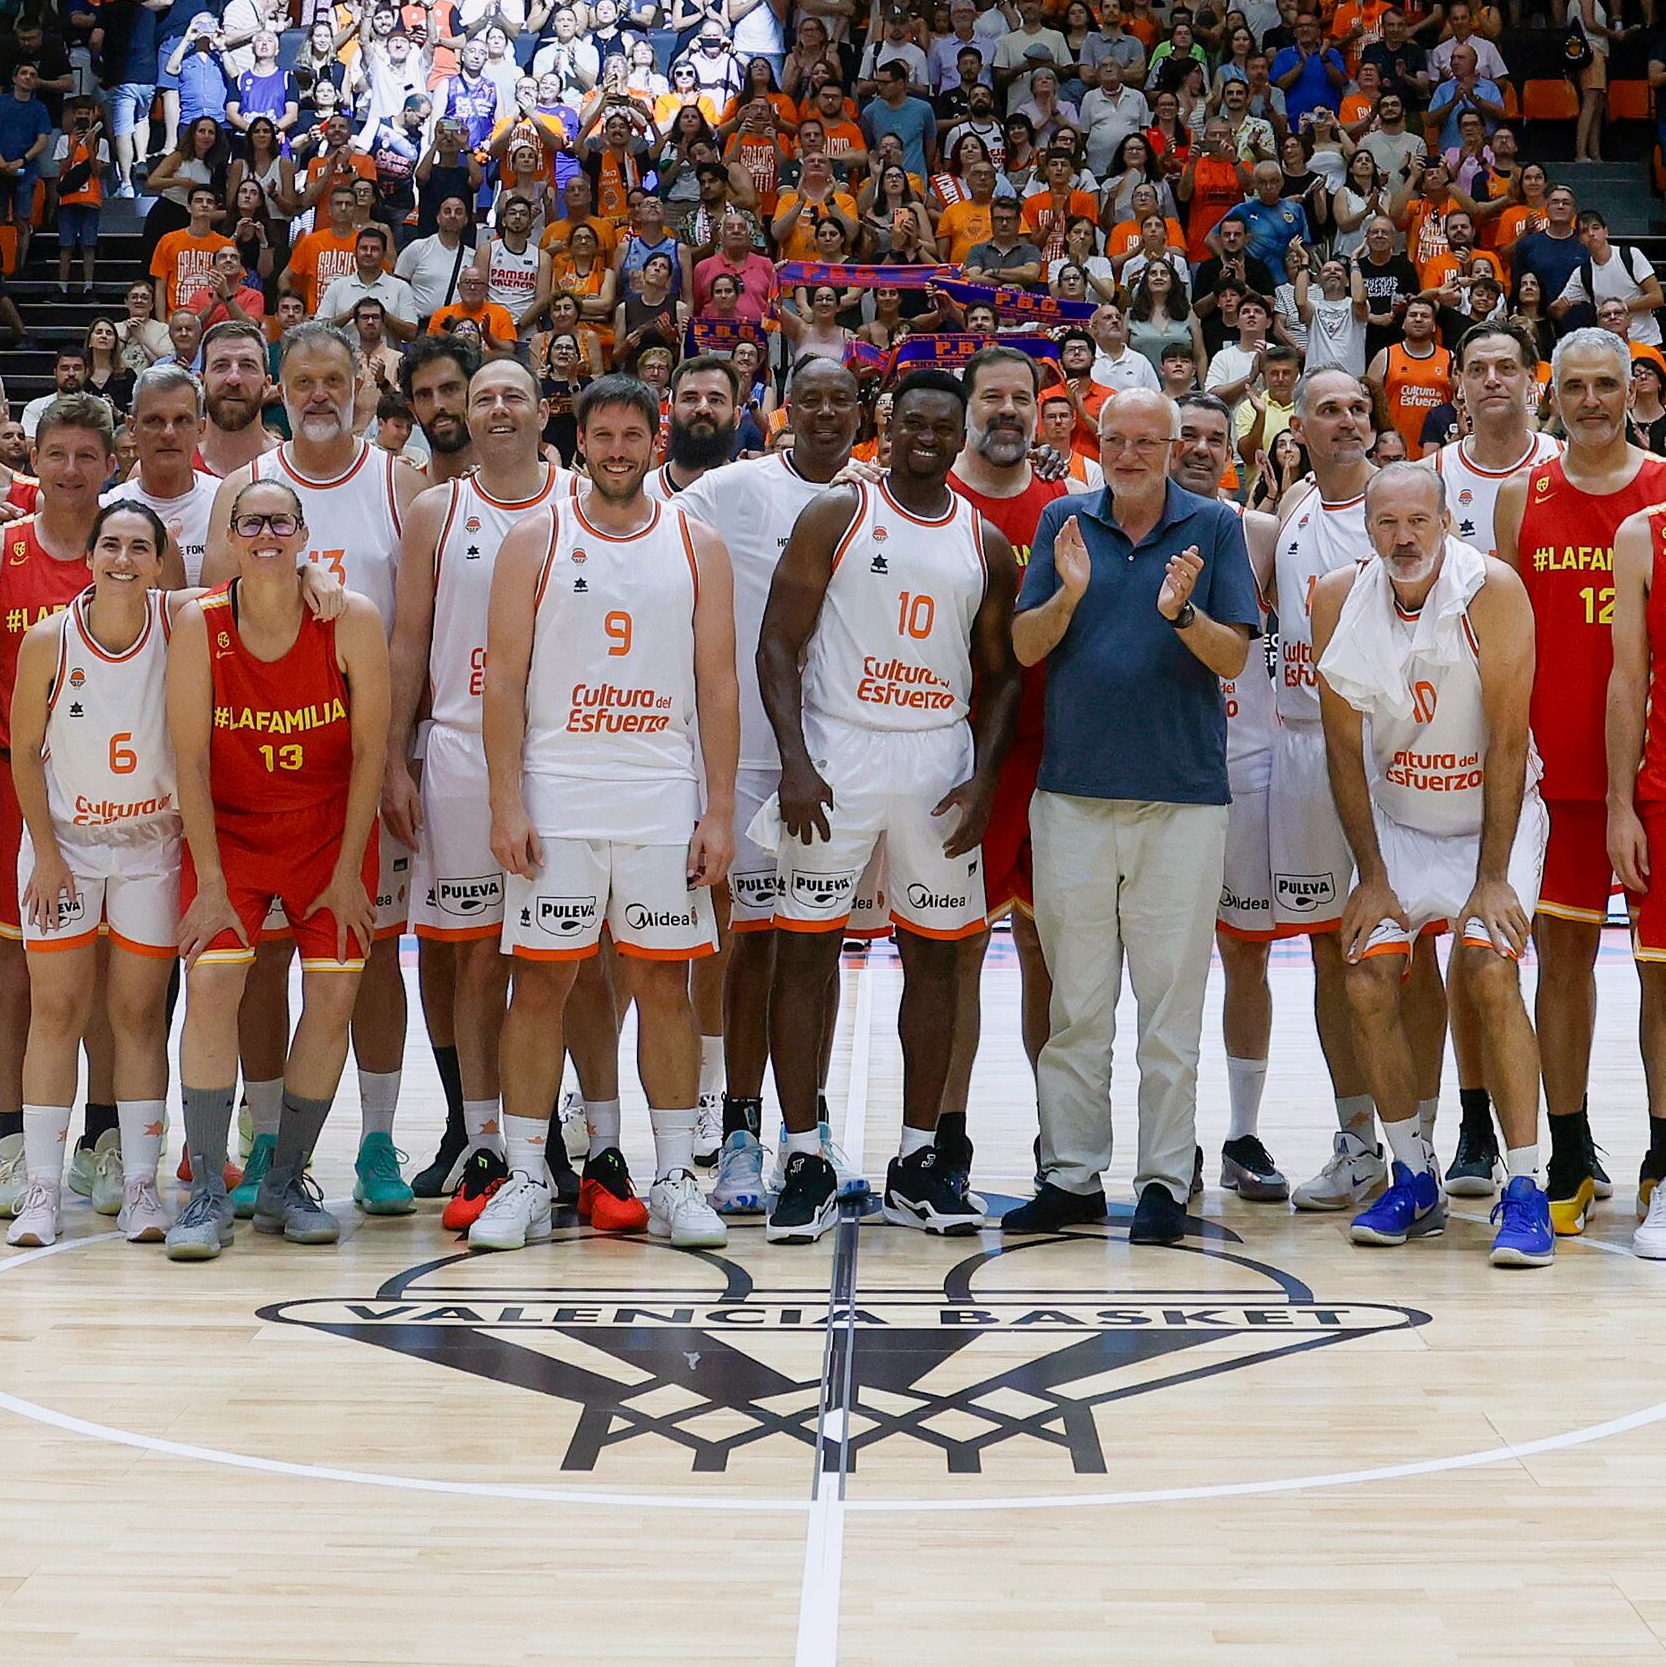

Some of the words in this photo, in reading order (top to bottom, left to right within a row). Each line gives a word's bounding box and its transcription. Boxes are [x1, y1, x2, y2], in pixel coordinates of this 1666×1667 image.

[490, 268, 536, 281] PAMESA
[1400, 385, 1435, 396] Cultura
[897, 590, 935, 640] 10
[1578, 586, 1615, 624] 12
[604, 609, 633, 657] 9
[571, 682, 655, 710] Cultura
[655, 694, 672, 709] del
[856, 677, 955, 711] Esfuerzo
[213, 697, 346, 735] #LAFAMILIA
[565, 707, 670, 734] Esfuerzo
[108, 732, 137, 775] 6
[257, 744, 304, 773] 13
[1458, 752, 1480, 767] del
[74, 794, 157, 819] Cultura
[440, 882, 500, 900] PULEVA
[794, 875, 851, 894] PULEVA
[1278, 880, 1331, 896] PULEVA
[540, 903, 595, 920] PULEVA
[918, 890, 966, 910] Midea
[344, 1304, 890, 1326] VALENCIA
[939, 1308, 1351, 1326] BASKET
